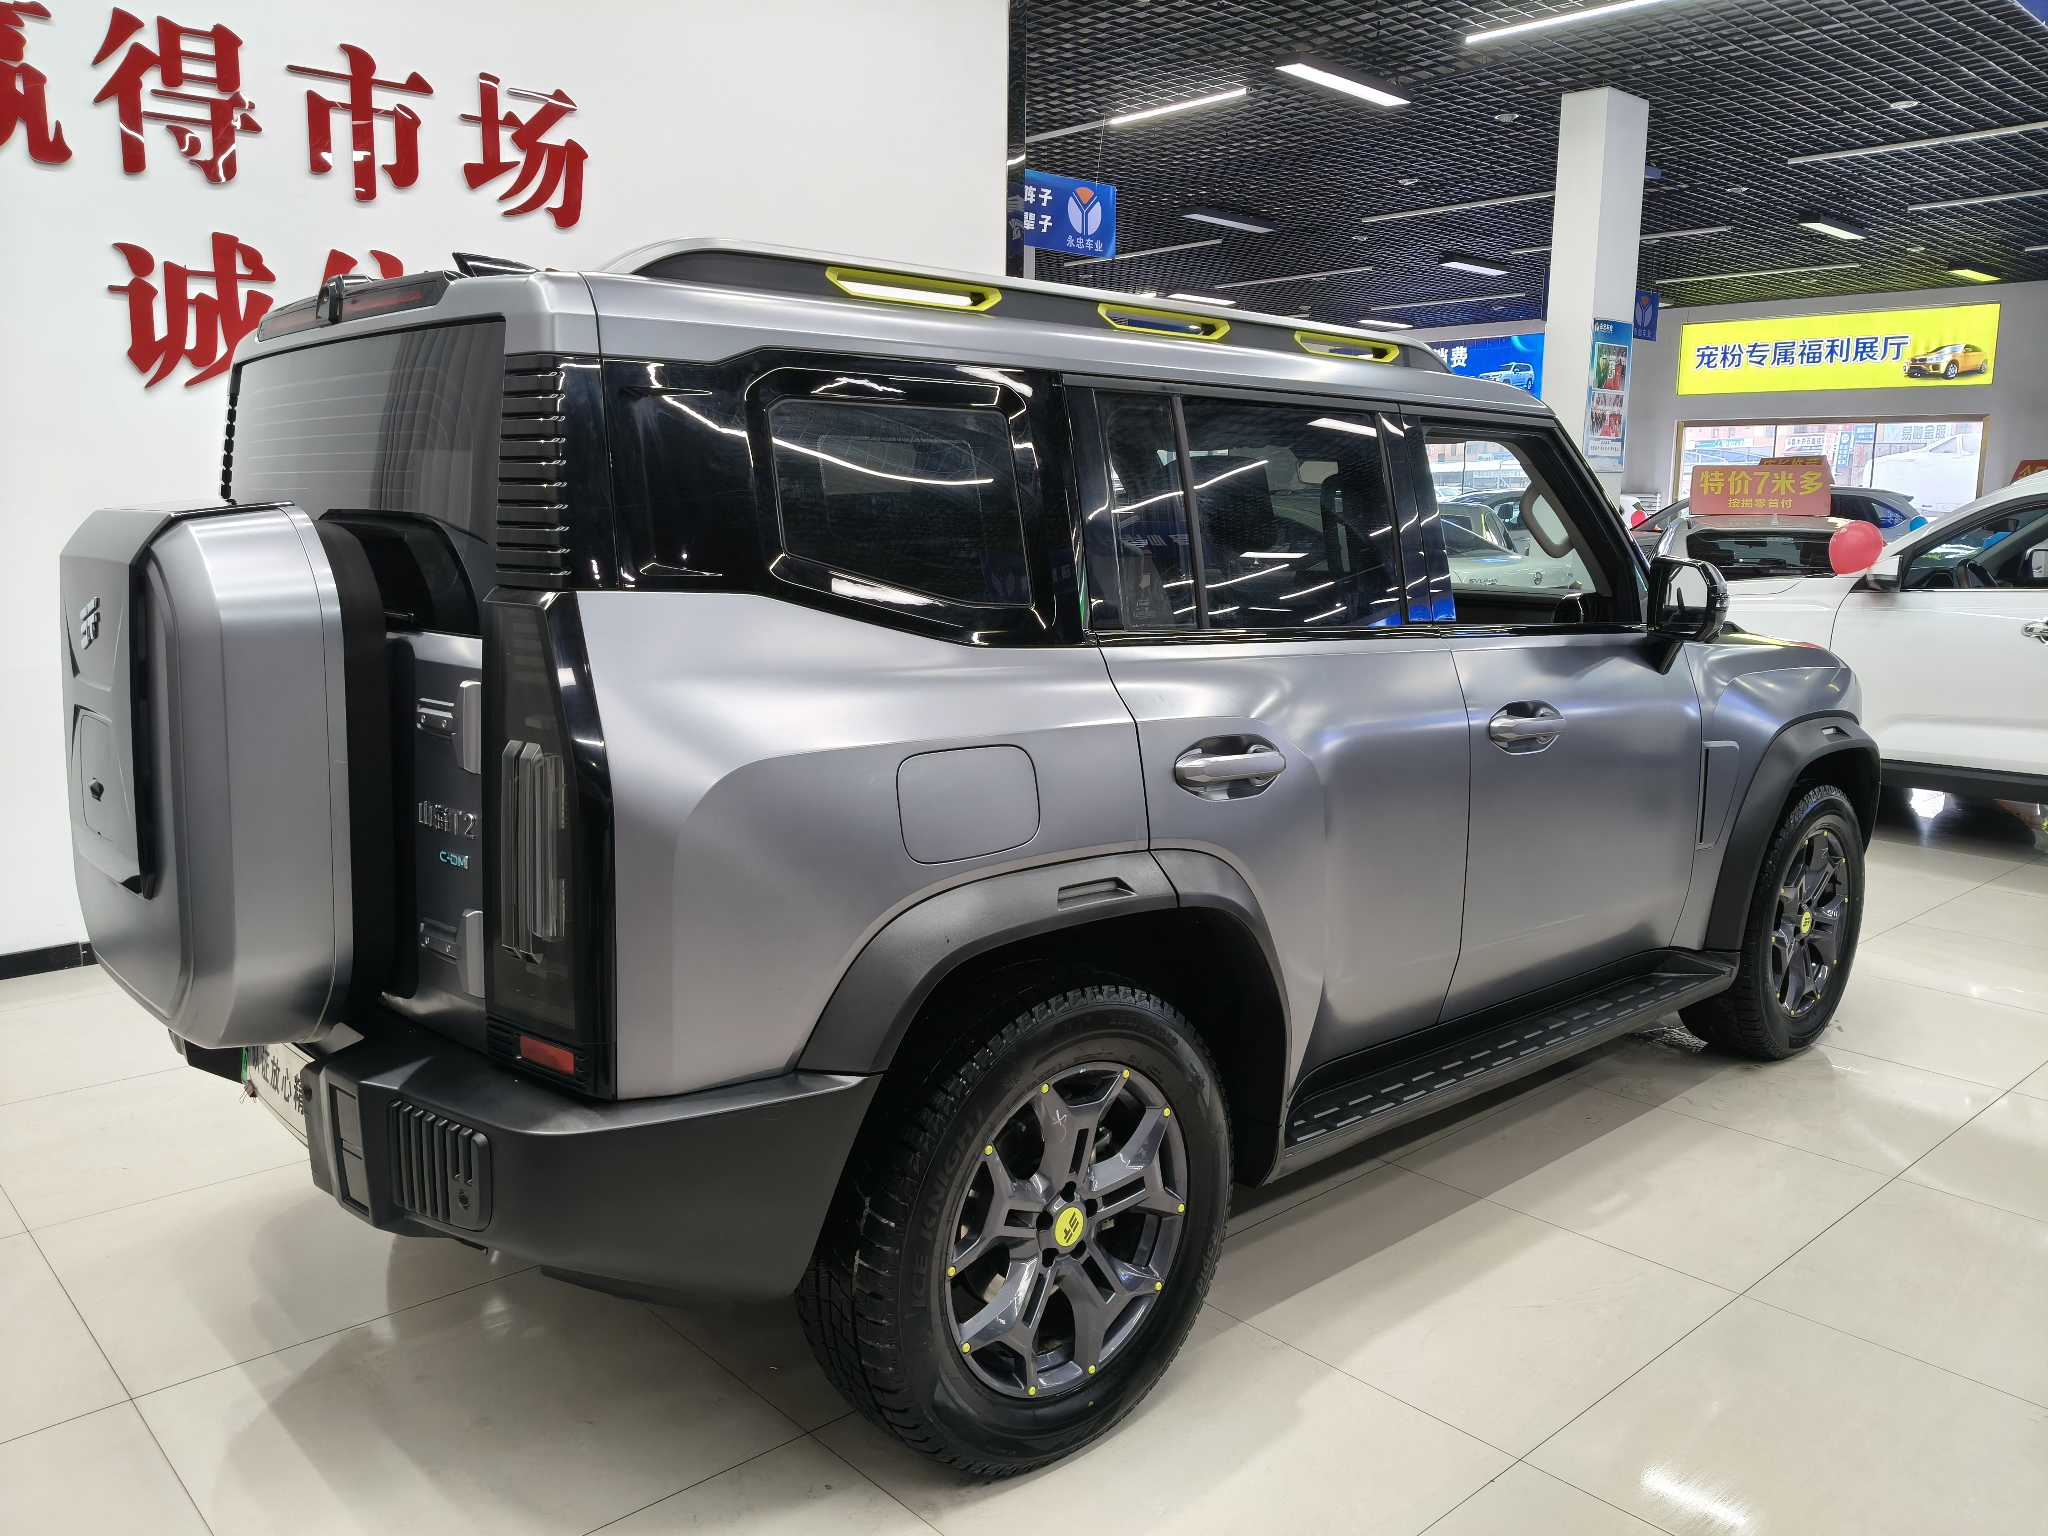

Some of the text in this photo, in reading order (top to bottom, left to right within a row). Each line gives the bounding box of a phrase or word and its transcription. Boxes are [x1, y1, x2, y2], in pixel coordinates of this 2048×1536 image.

[1066, 234, 1104, 252] 永忠车业
[1695, 335, 1910, 370] 宠粉专属福利展厅
[1700, 470, 1825, 497] 特价7米多
